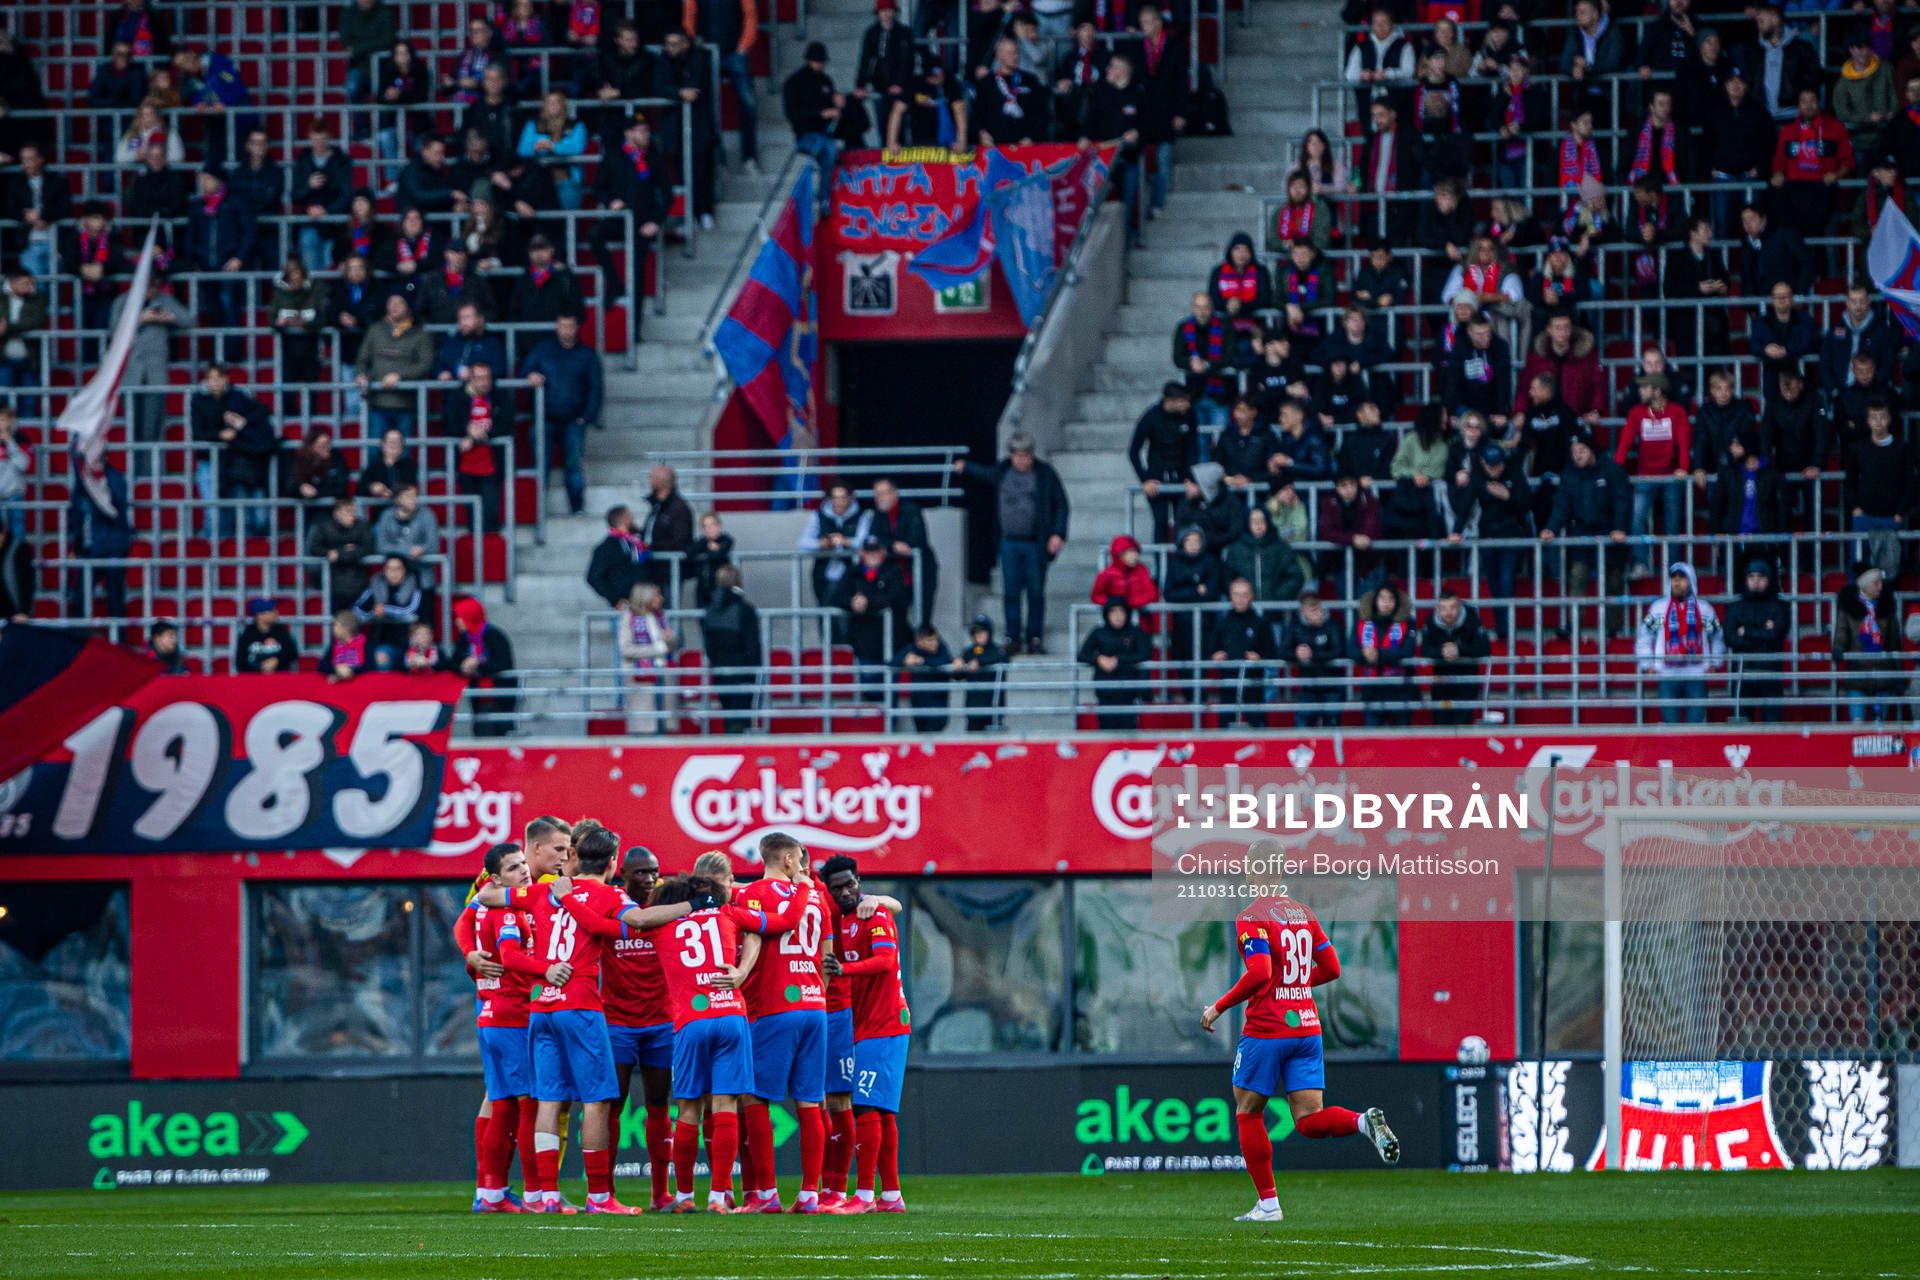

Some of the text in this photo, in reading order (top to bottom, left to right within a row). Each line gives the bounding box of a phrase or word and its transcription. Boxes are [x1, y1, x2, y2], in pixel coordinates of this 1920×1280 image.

[52, 700, 444, 840] 1985
[671, 754, 922, 846] Carlsberg
[547, 908, 577, 961] 13
[675, 916, 725, 968] 31
[778, 899, 822, 957] 20
[790, 960, 816, 973] OLSSO
[1281, 928, 1313, 985] 39
[708, 990, 734, 1002] Solid
[801, 984, 821, 997] Solid
[1275, 986, 1290, 1000] VAN
[839, 1056, 854, 1075] 19
[858, 1069, 877, 1089] 27
[88, 1099, 241, 1158] akea
[1075, 1084, 1232, 1144] akea
[1456, 1083, 1478, 1162] SELECT
